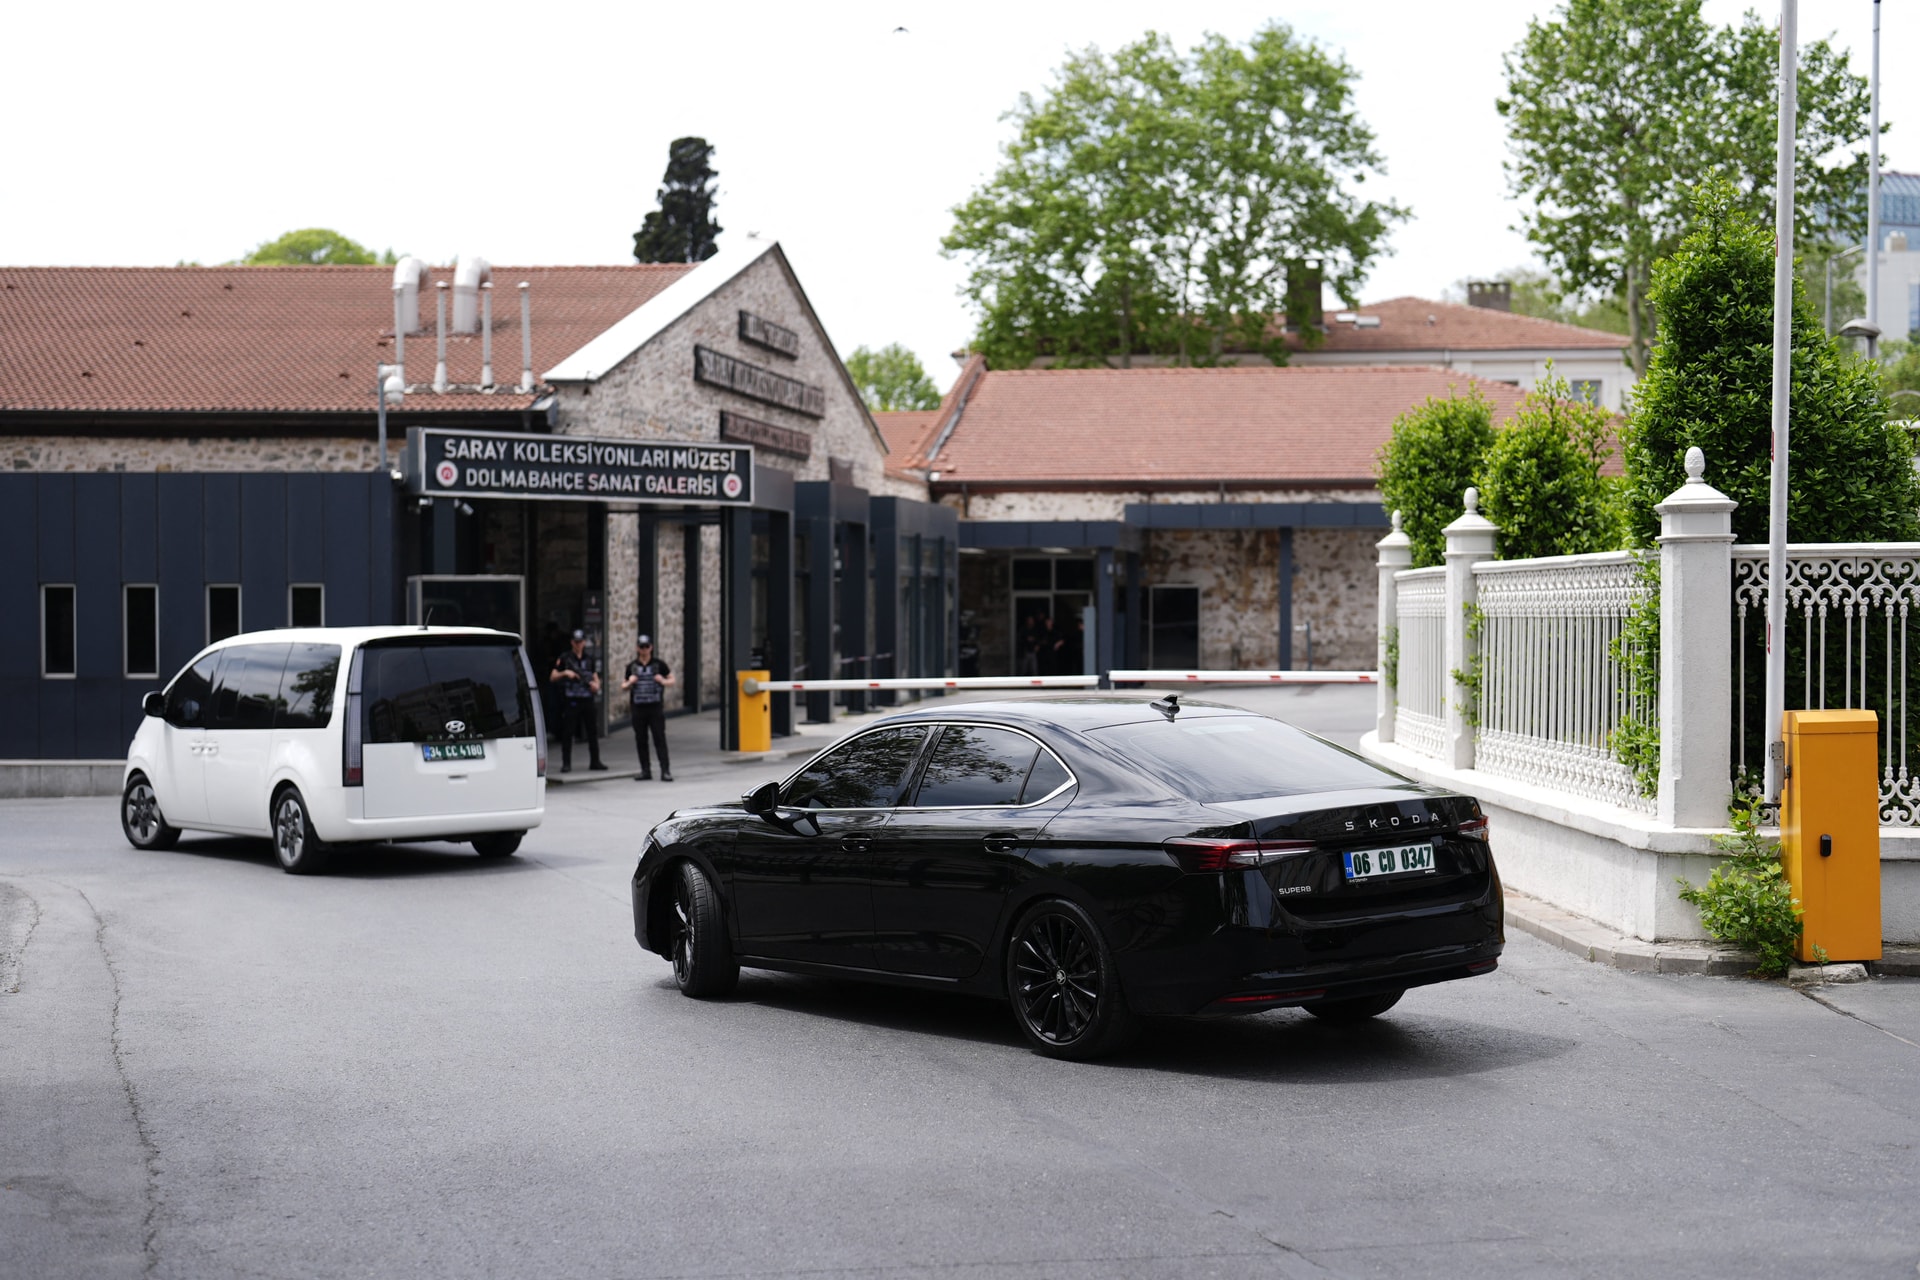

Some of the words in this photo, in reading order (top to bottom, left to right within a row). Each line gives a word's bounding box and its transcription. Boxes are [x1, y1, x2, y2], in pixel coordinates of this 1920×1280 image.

[444, 438, 508, 460] SARAY
[513, 442, 670, 468] KOLEKSİYONLARI
[672, 448, 736, 472] MÜZESİ
[465, 468, 584, 491] DOLMABAHÇE
[588, 473, 642, 492] SANAT
[645, 474, 718, 496] GALERİSİ
[430, 746, 442, 757] 34
[445, 745, 458, 757] CC
[460, 744, 483, 756] 4180
[1344, 812, 1440, 831] SKODA
[1345, 866, 1353, 874] TR
[1353, 852, 1371, 875] 06
[1378, 850, 1396, 873] CD
[1400, 846, 1432, 870] 0347
[1278, 885, 1312, 895] SUPERB
